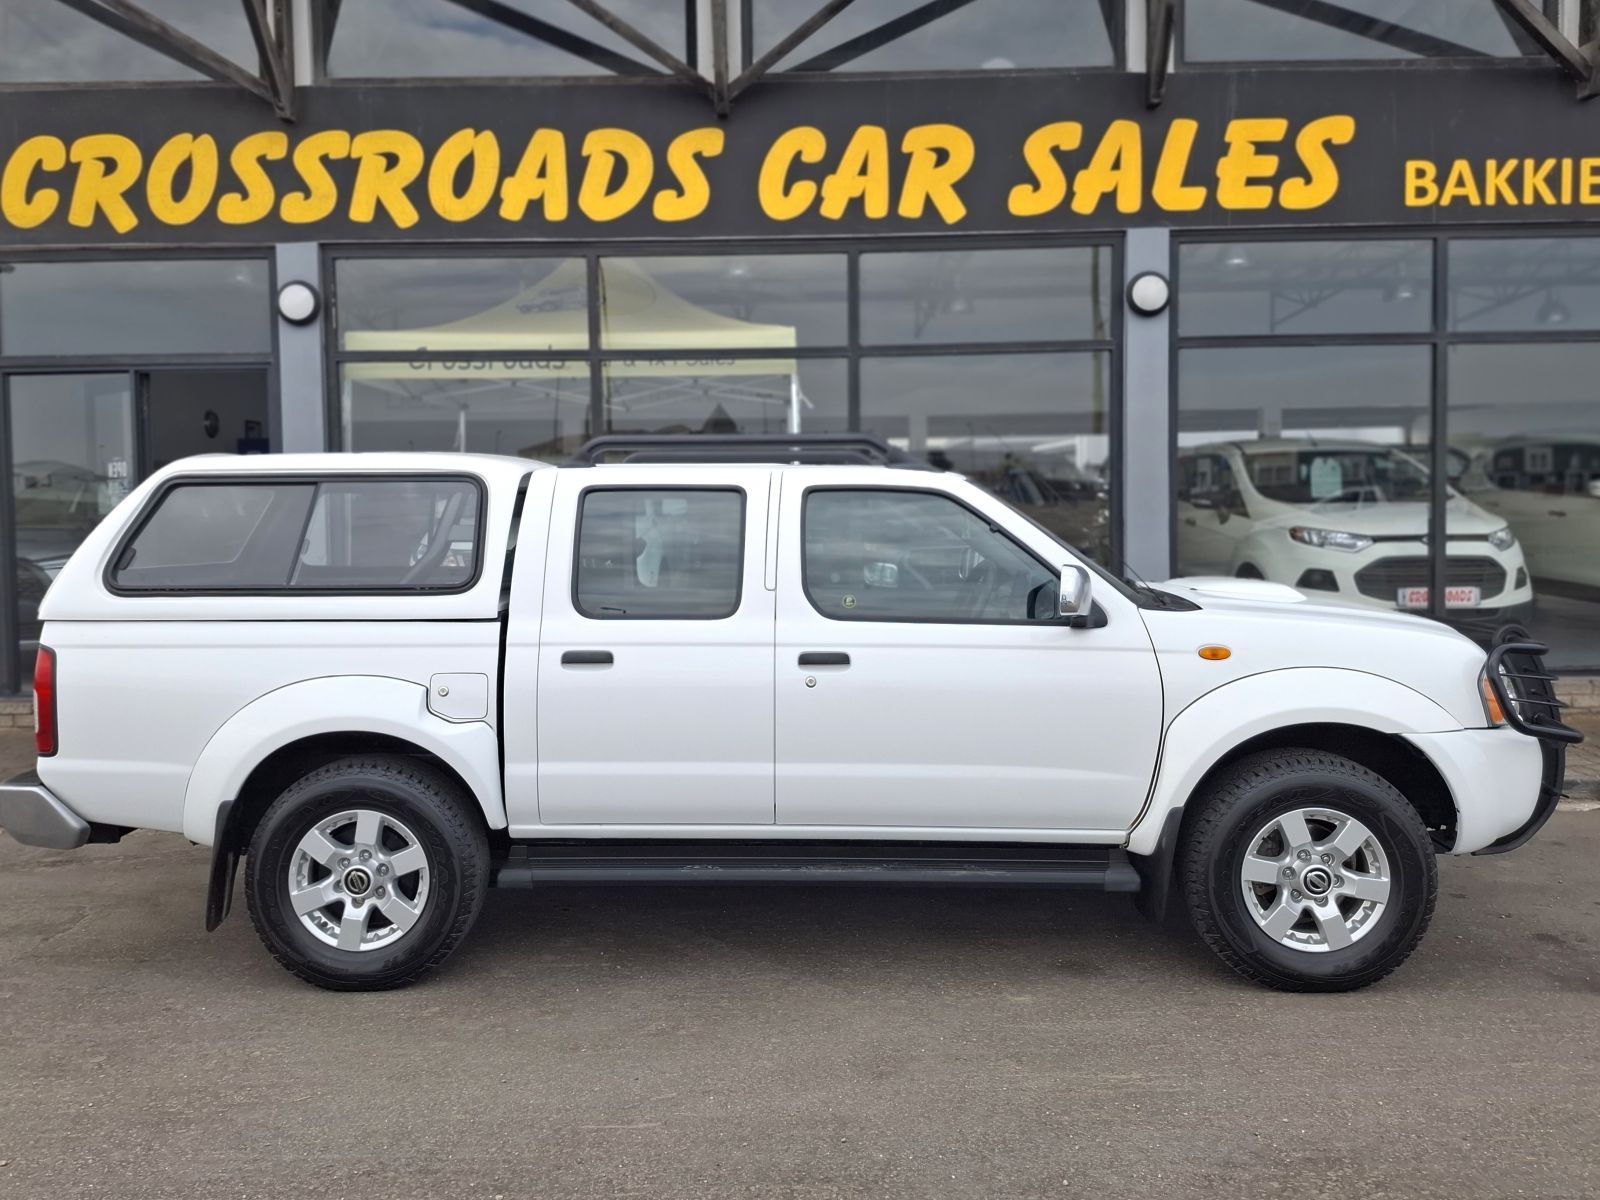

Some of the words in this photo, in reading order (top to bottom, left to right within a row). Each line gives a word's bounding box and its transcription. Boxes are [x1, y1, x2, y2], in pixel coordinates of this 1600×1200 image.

[0, 127, 724, 233] CROSSROADS
[758, 123, 976, 224] CAR
[1008, 115, 1356, 217] SALES
